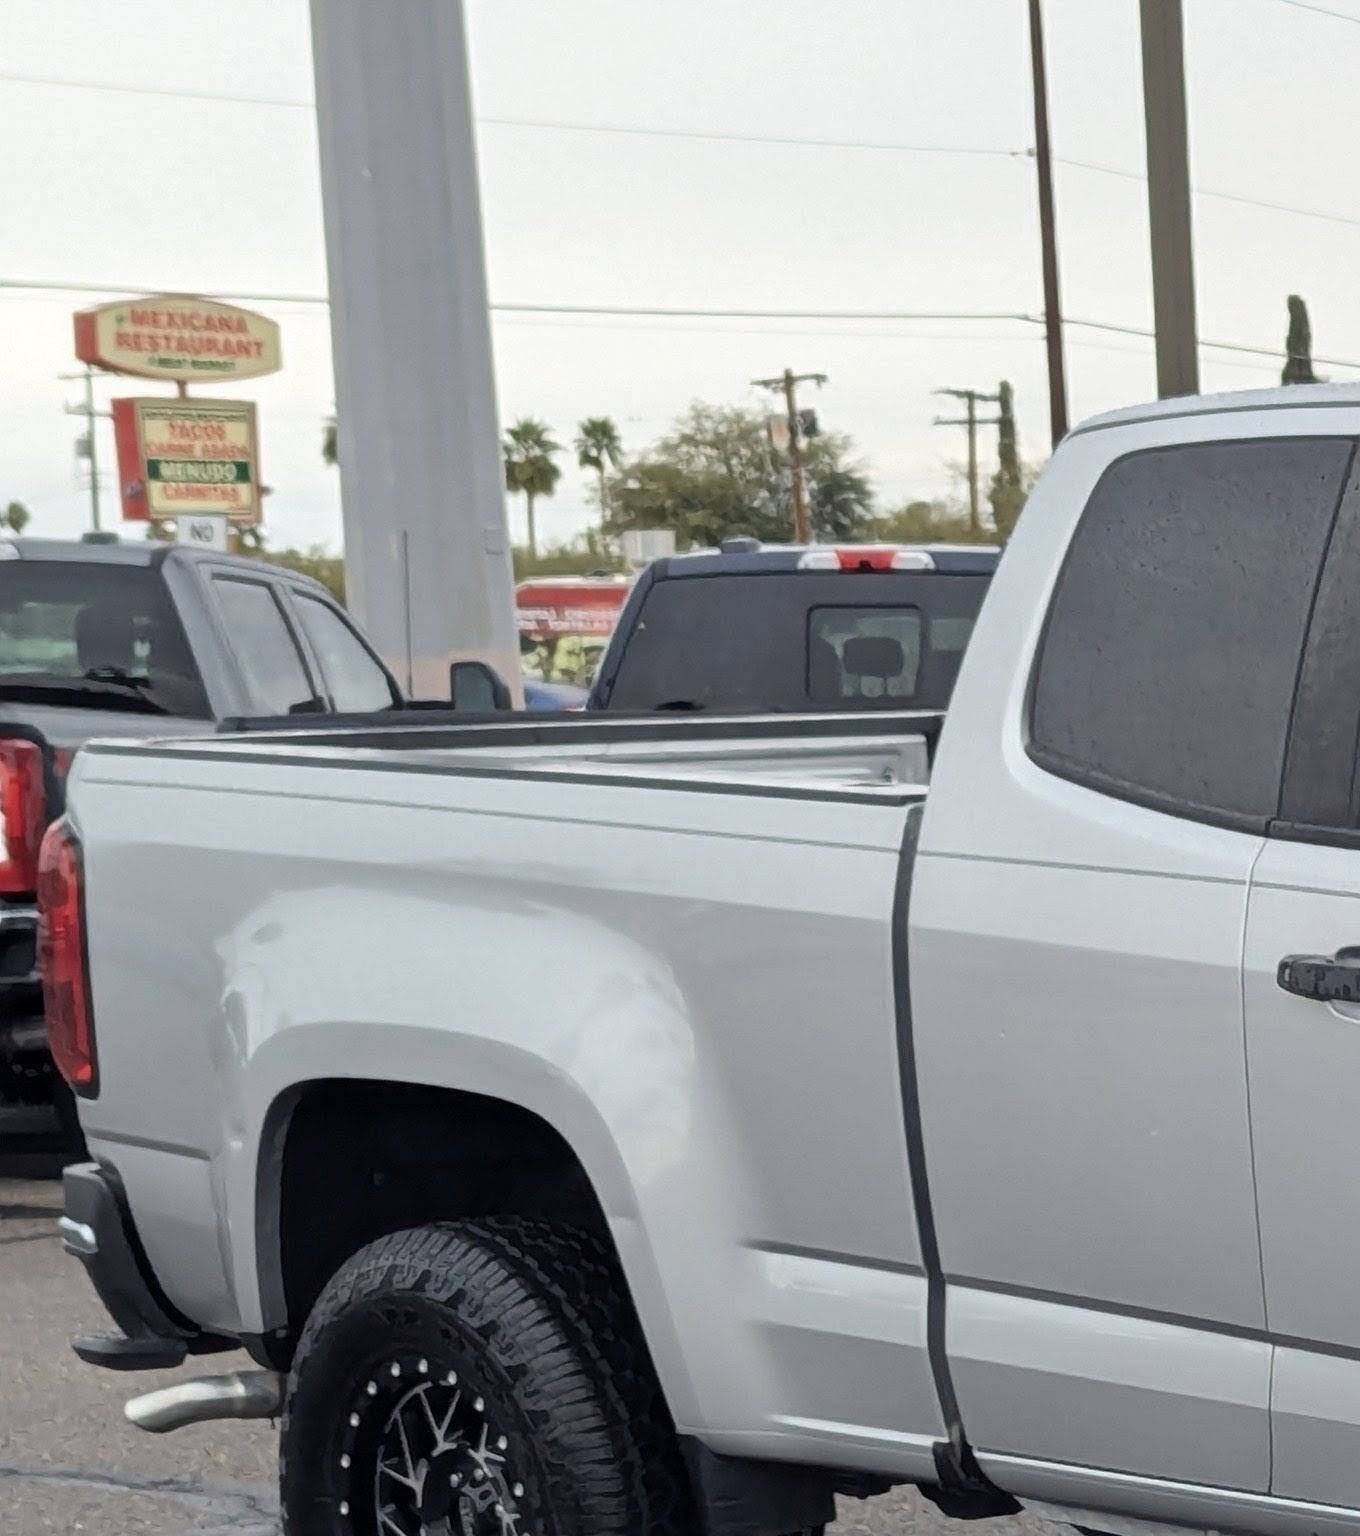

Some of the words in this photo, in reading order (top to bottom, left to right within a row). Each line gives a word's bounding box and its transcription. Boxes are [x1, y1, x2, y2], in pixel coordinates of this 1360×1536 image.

[131, 309, 248, 333] MEXICANA
[115, 331, 264, 358] RESTAURANT
[169, 421, 226, 440] TACOS
[159, 461, 237, 482] MENUDO
[191, 523, 214, 542] NO
